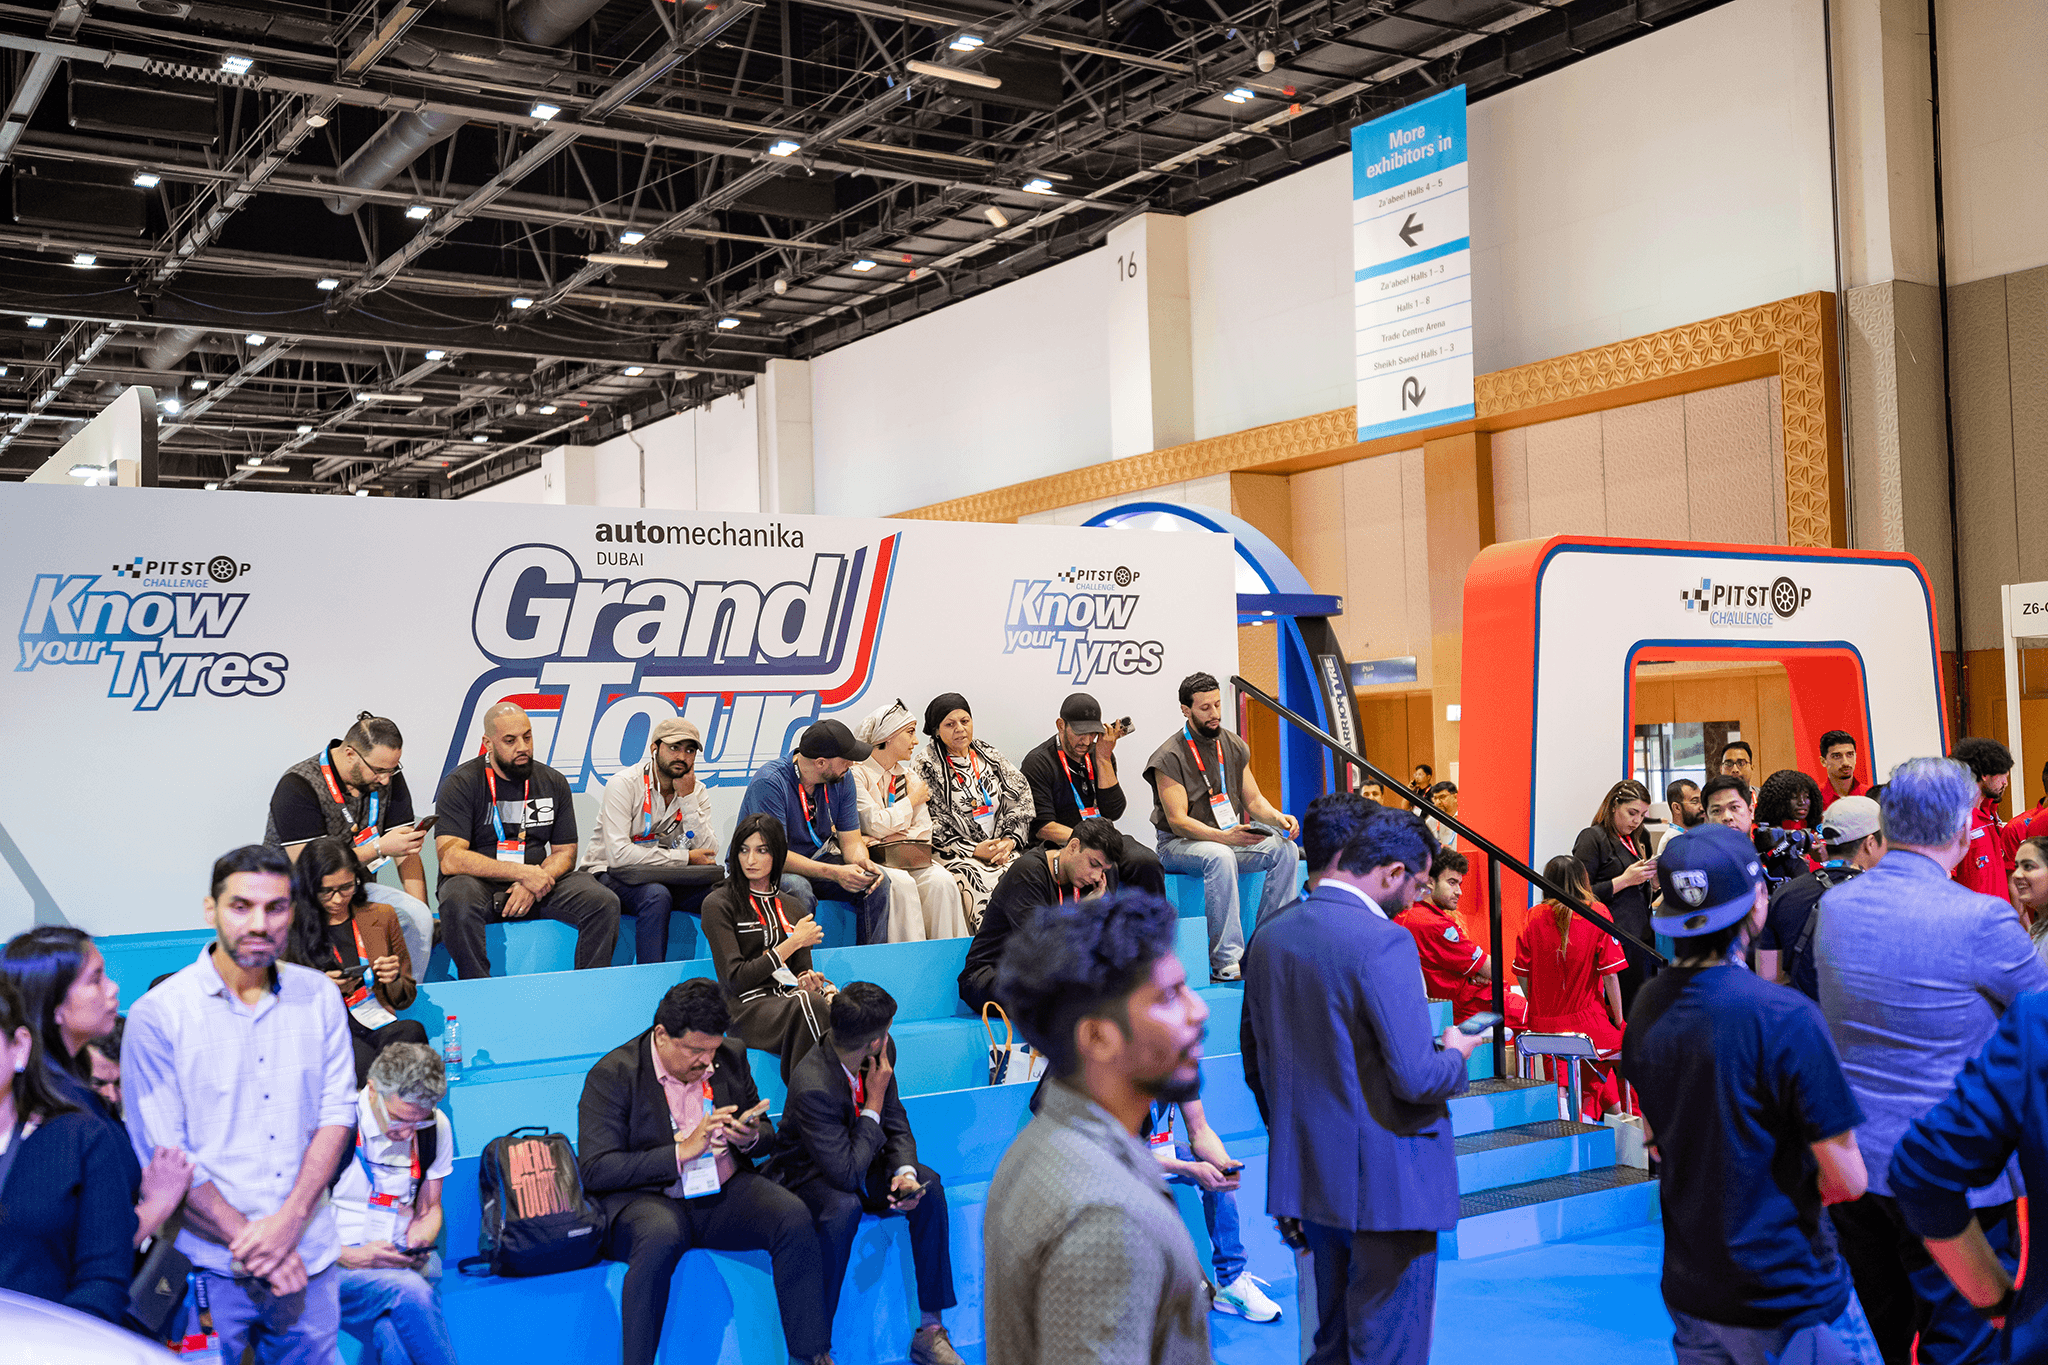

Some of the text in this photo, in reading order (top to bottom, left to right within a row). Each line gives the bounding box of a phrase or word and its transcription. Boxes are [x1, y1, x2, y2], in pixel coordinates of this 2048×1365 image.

[1388, 125, 1426, 150] More
[1366, 135, 1452, 179] exhibitors in
[1407, 186, 1425, 198] Halls
[1425, 182, 1431, 191] 4
[1438, 178, 1443, 188] 5
[1117, 250, 1138, 282] 16
[1410, 271, 1428, 283] Halls
[1439, 264, 1445, 274] 3
[1396, 302, 1414, 313] Halls
[1425, 296, 1431, 305] 8
[1381, 320, 1446, 343] Trade Centre Arena
[1373, 359, 1397, 371] Sheikh
[1398, 353, 1420, 365] Saeed
[1420, 348, 1438, 360] Halls
[1449, 343, 1455, 352] 3
[594, 520, 805, 549] automechanika
[596, 551, 645, 567] DUBAI
[142, 577, 210, 589] CHALLENGE
[1075, 582, 1116, 592] CHALLENGE
[20, 573, 249, 638] Know
[473, 545, 846, 661] Grand
[1005, 579, 1140, 629] Know
[1710, 611, 1774, 626] CHALLENGE
[1003, 629, 1164, 685] your Tyres
[16, 638, 288, 711] your Tyres
[537, 661, 823, 792] Tour
